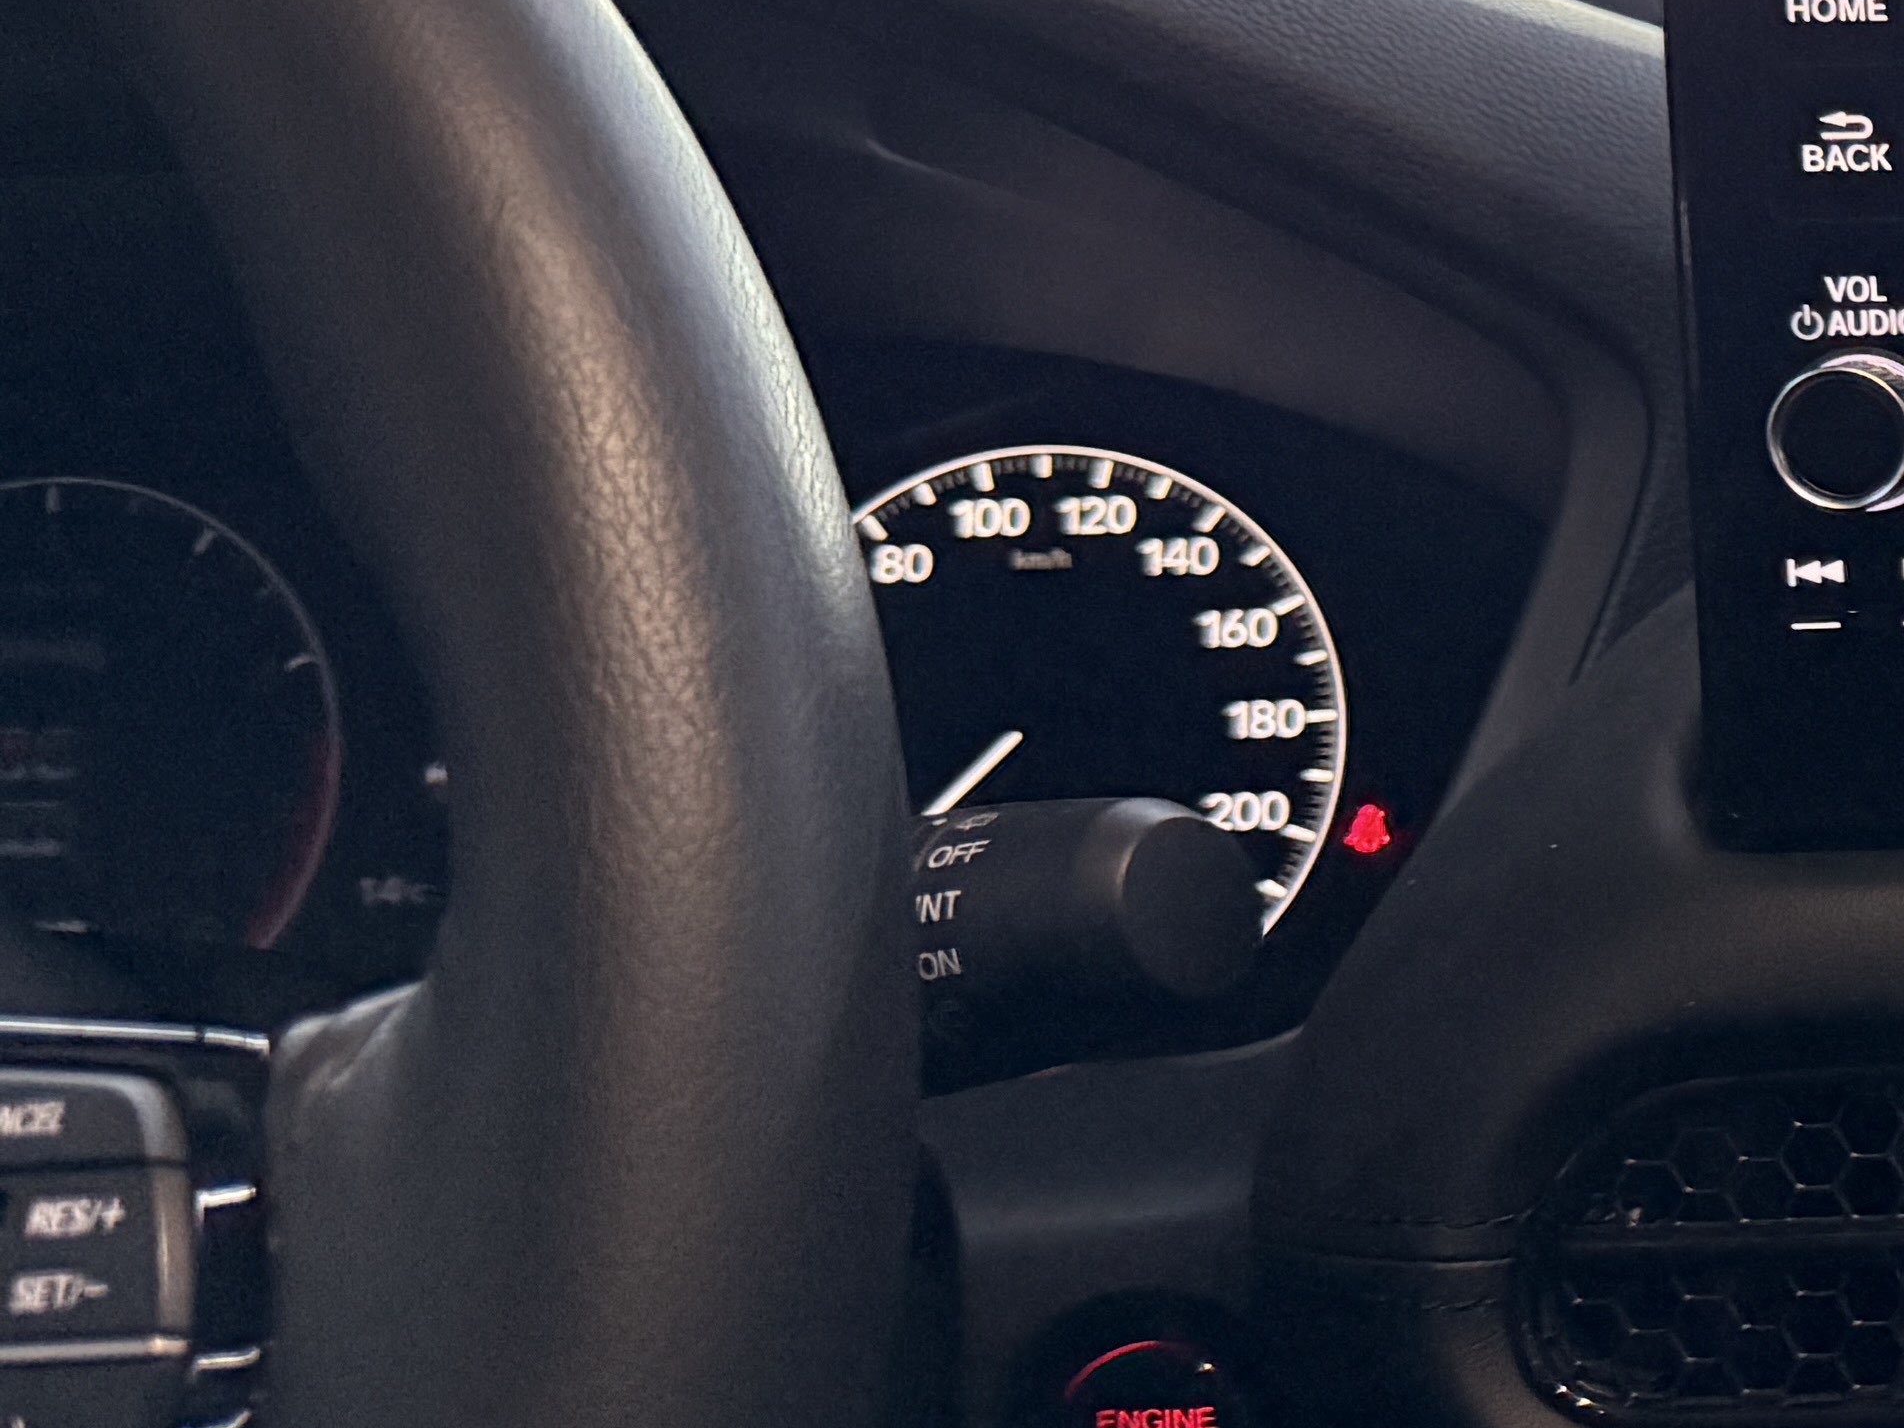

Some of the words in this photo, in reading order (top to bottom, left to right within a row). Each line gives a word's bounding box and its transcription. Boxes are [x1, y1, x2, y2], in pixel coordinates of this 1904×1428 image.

[1801, 143, 1893, 173] BACK
[1823, 275, 1888, 303] VOL
[949, 497, 1031, 539] 100
[1057, 494, 1137, 536] 120
[870, 543, 934, 584] 80
[1137, 536, 1220, 577] 140
[1197, 608, 1279, 649] 160
[1222, 699, 1307, 740] 180
[1203, 791, 1290, 832] 200
[927, 839, 990, 869] OFF
[918, 947, 962, 980] ON
